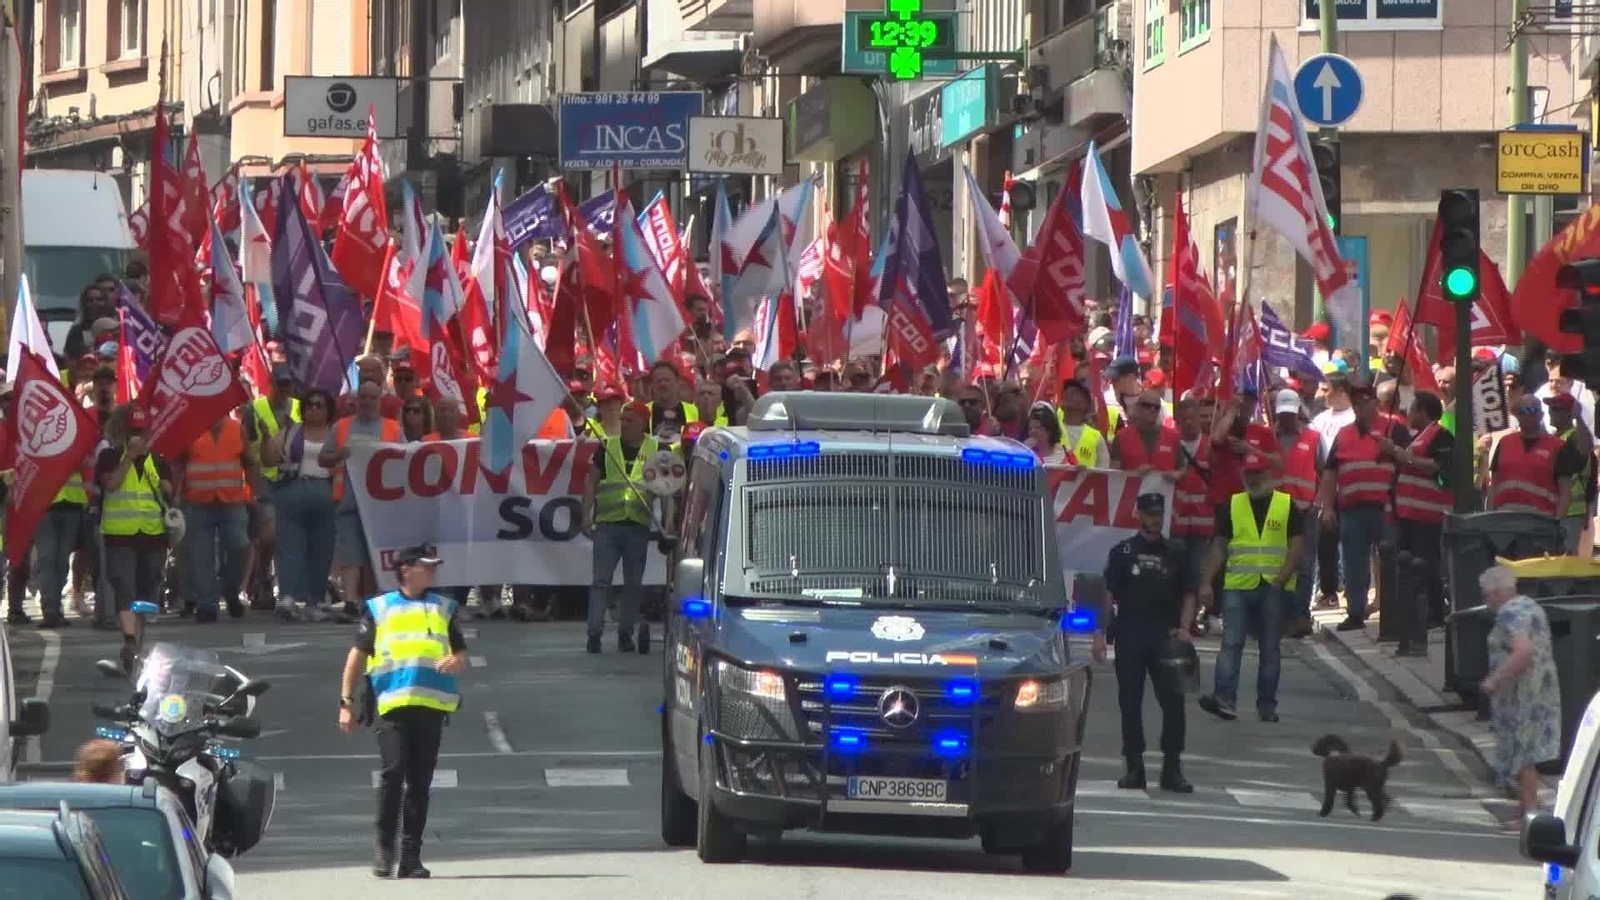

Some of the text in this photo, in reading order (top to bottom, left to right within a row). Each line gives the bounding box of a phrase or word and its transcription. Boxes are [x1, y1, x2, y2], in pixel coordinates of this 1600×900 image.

[870, 21, 937, 47] 12:39
[1501, 171, 1579, 180] COMPRA VENTA
[1538, 183, 1560, 191] ORO
[826, 651, 948, 666] POLICIA
[860, 779, 945, 798] CNP3869BC
